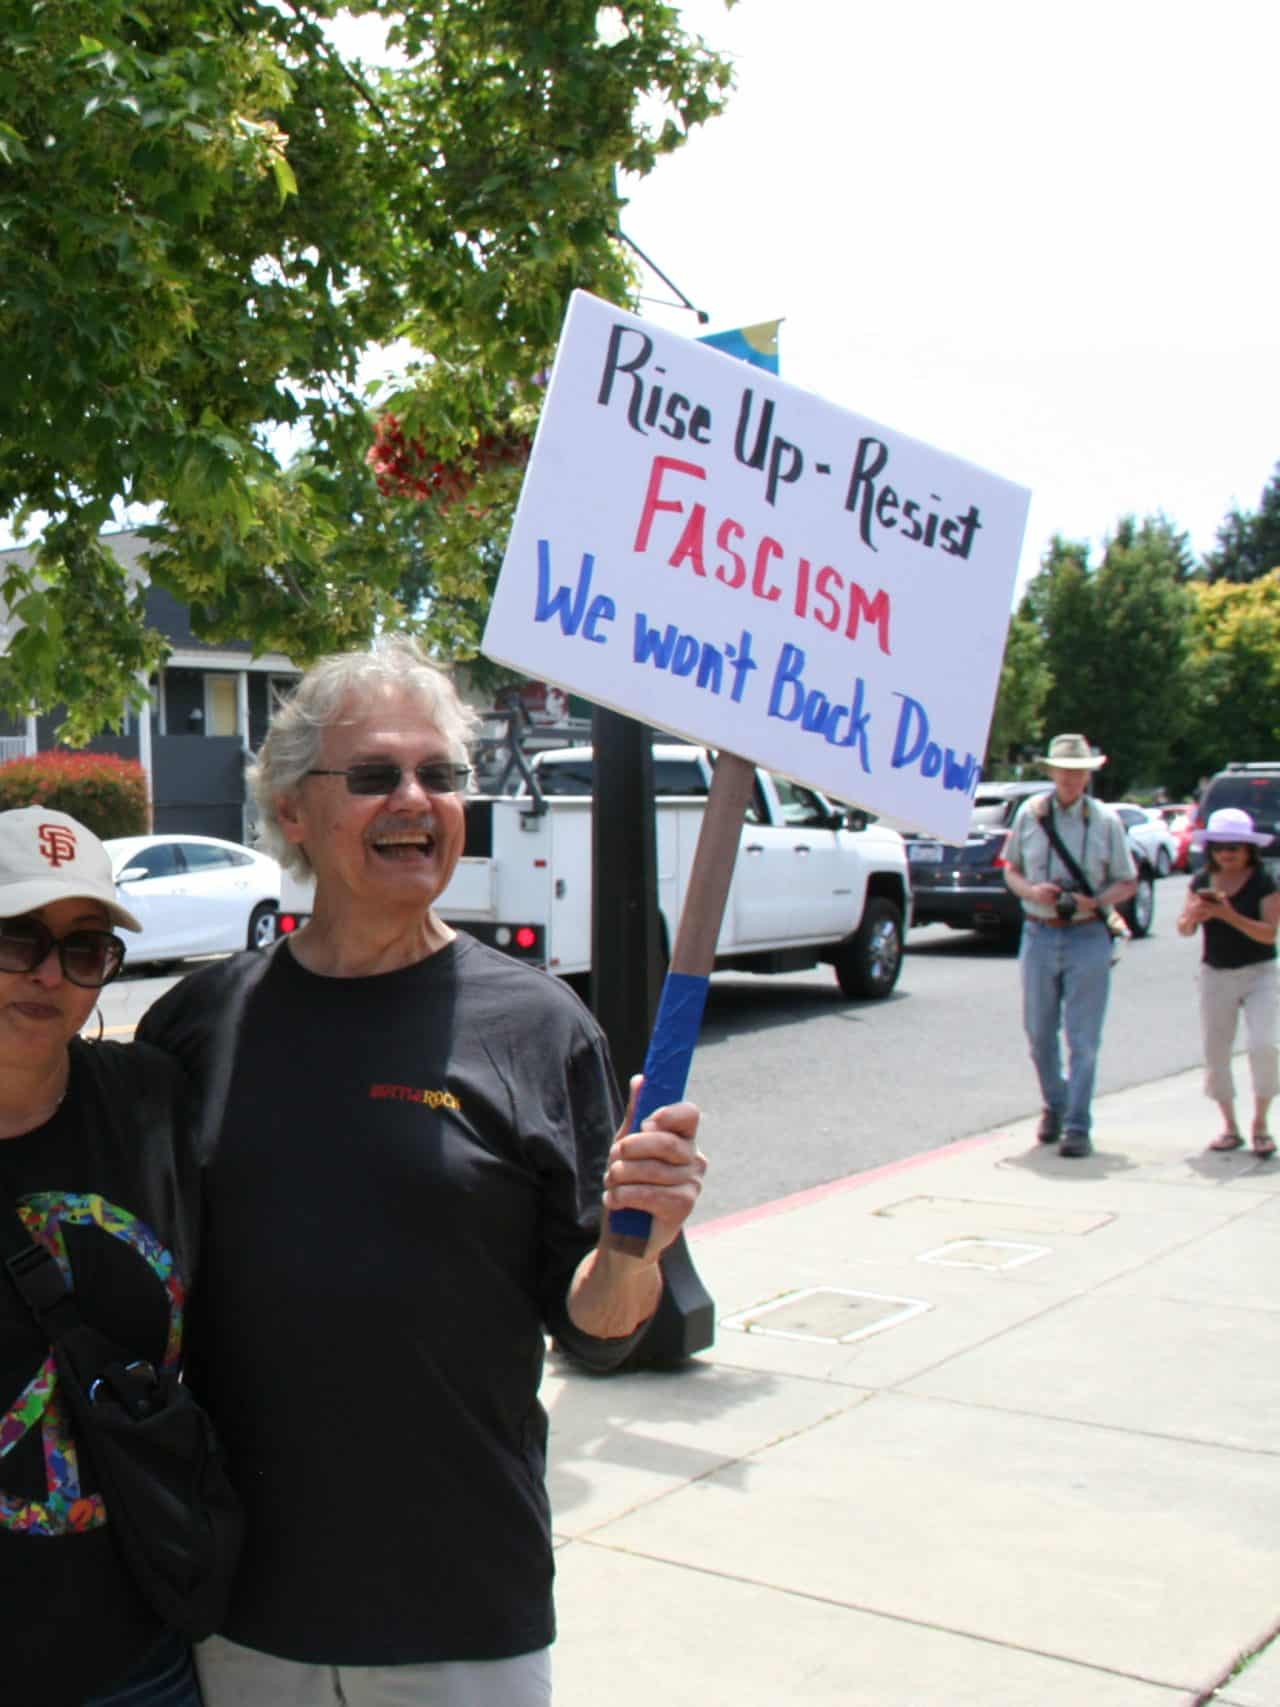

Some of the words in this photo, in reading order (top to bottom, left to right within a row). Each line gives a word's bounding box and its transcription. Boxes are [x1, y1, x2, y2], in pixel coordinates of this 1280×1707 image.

[598, 324, 711, 444] Rise
[633, 455, 891, 653] FASCISM
[534, 539, 616, 644] We
[633, 612, 757, 702] won't
[767, 642, 872, 774] Back
[39, 824, 76, 867] SF
